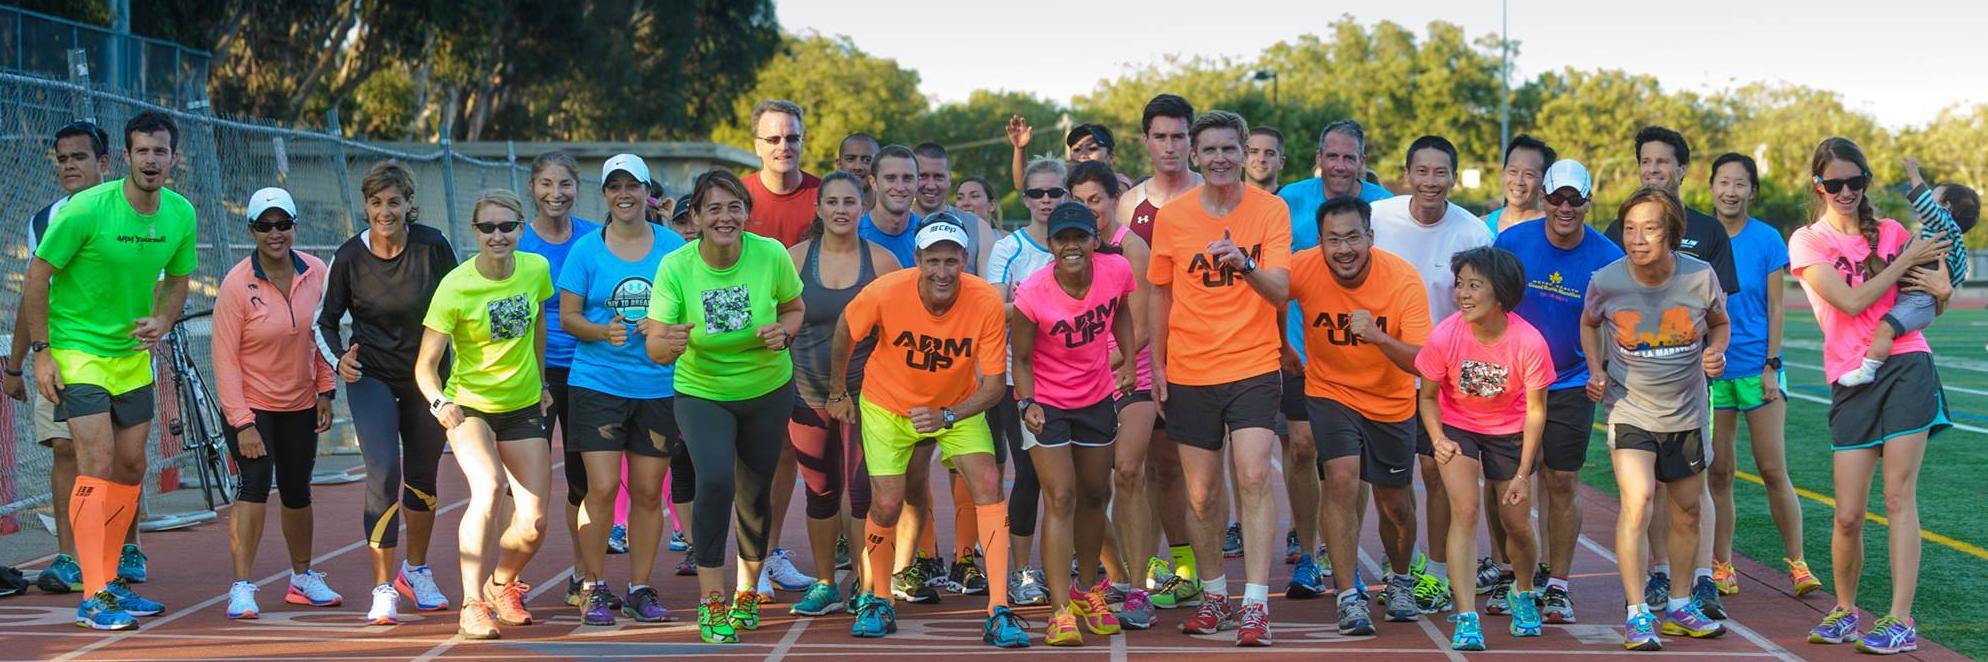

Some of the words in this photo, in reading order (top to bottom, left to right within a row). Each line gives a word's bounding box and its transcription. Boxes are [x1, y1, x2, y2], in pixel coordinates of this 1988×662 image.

[631, 299, 650, 307] BREA
[1048, 296, 1118, 337] ARM
[892, 330, 973, 358] ARM
[1065, 320, 1106, 349] UP
[905, 349, 954, 373] UP
